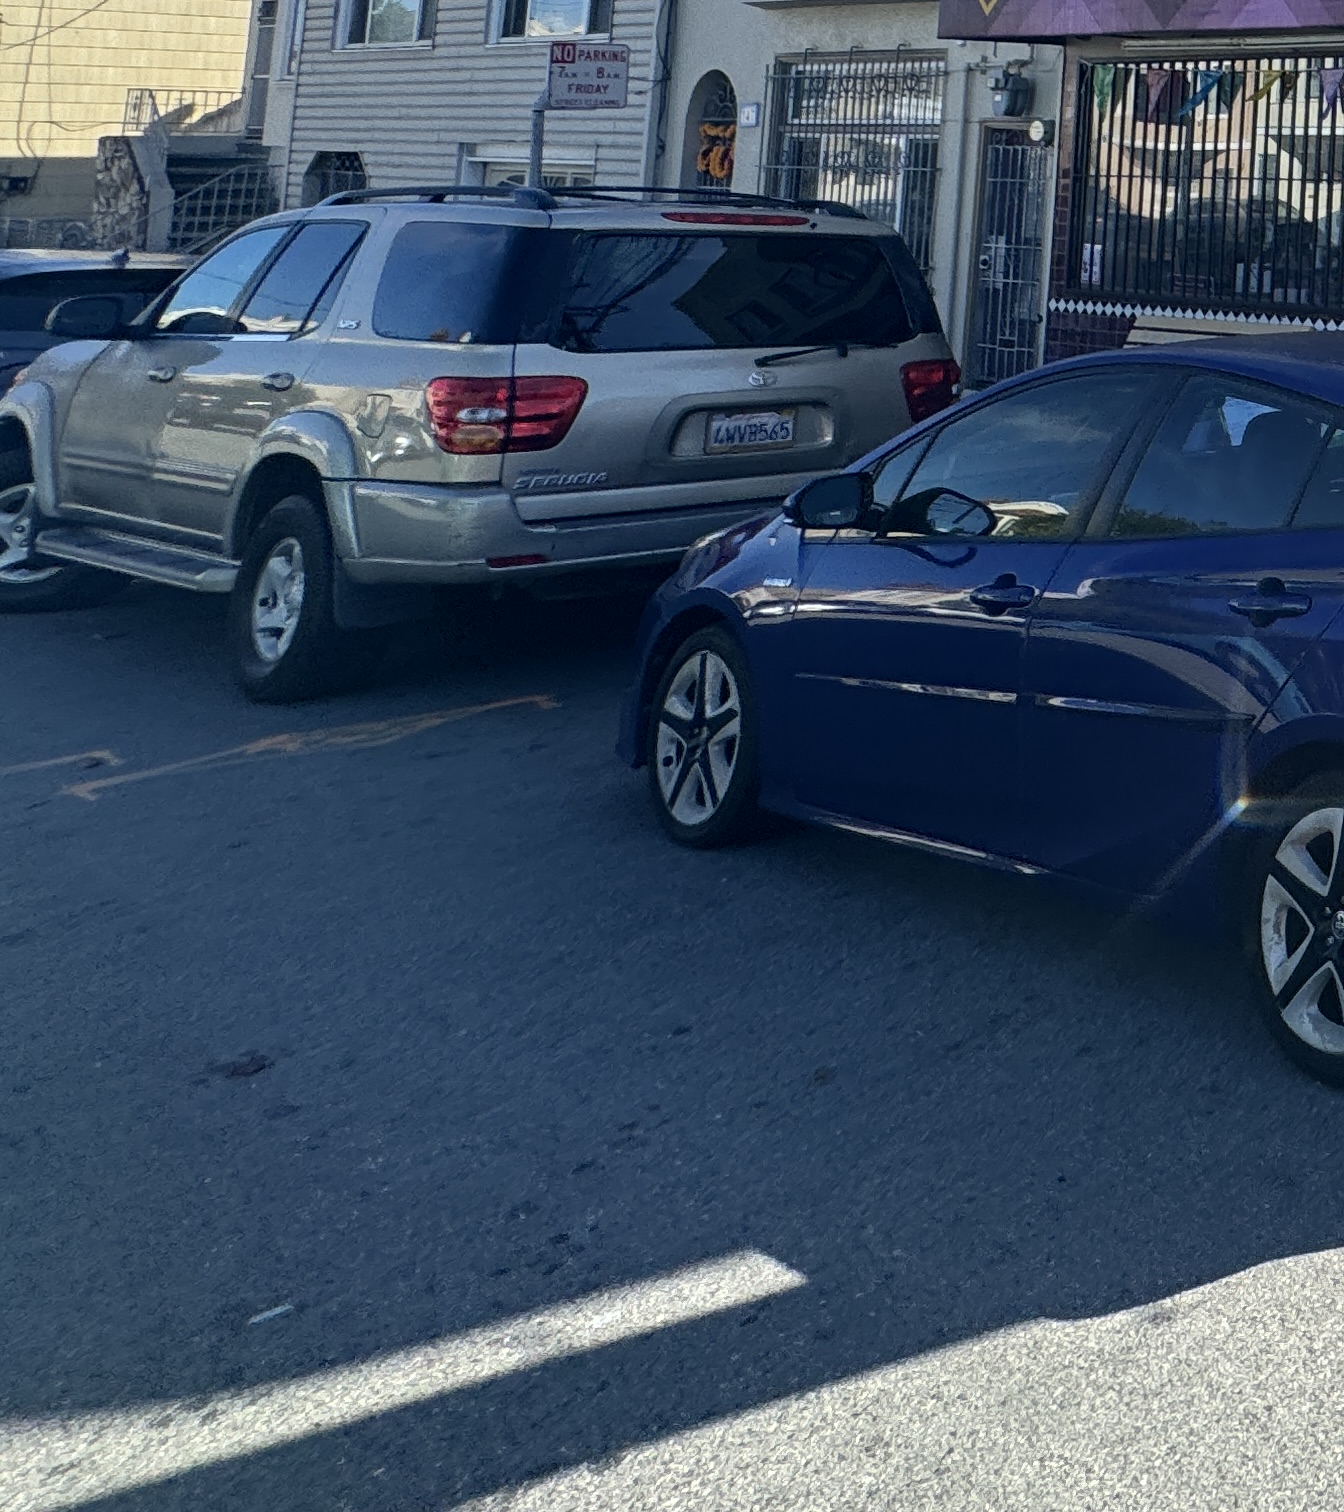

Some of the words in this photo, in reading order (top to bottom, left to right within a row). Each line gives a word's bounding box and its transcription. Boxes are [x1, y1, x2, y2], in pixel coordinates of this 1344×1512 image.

[552, 44, 574, 62] NO
[578, 50, 626, 62] PARKING
[567, 83, 609, 94] FRIDAY
